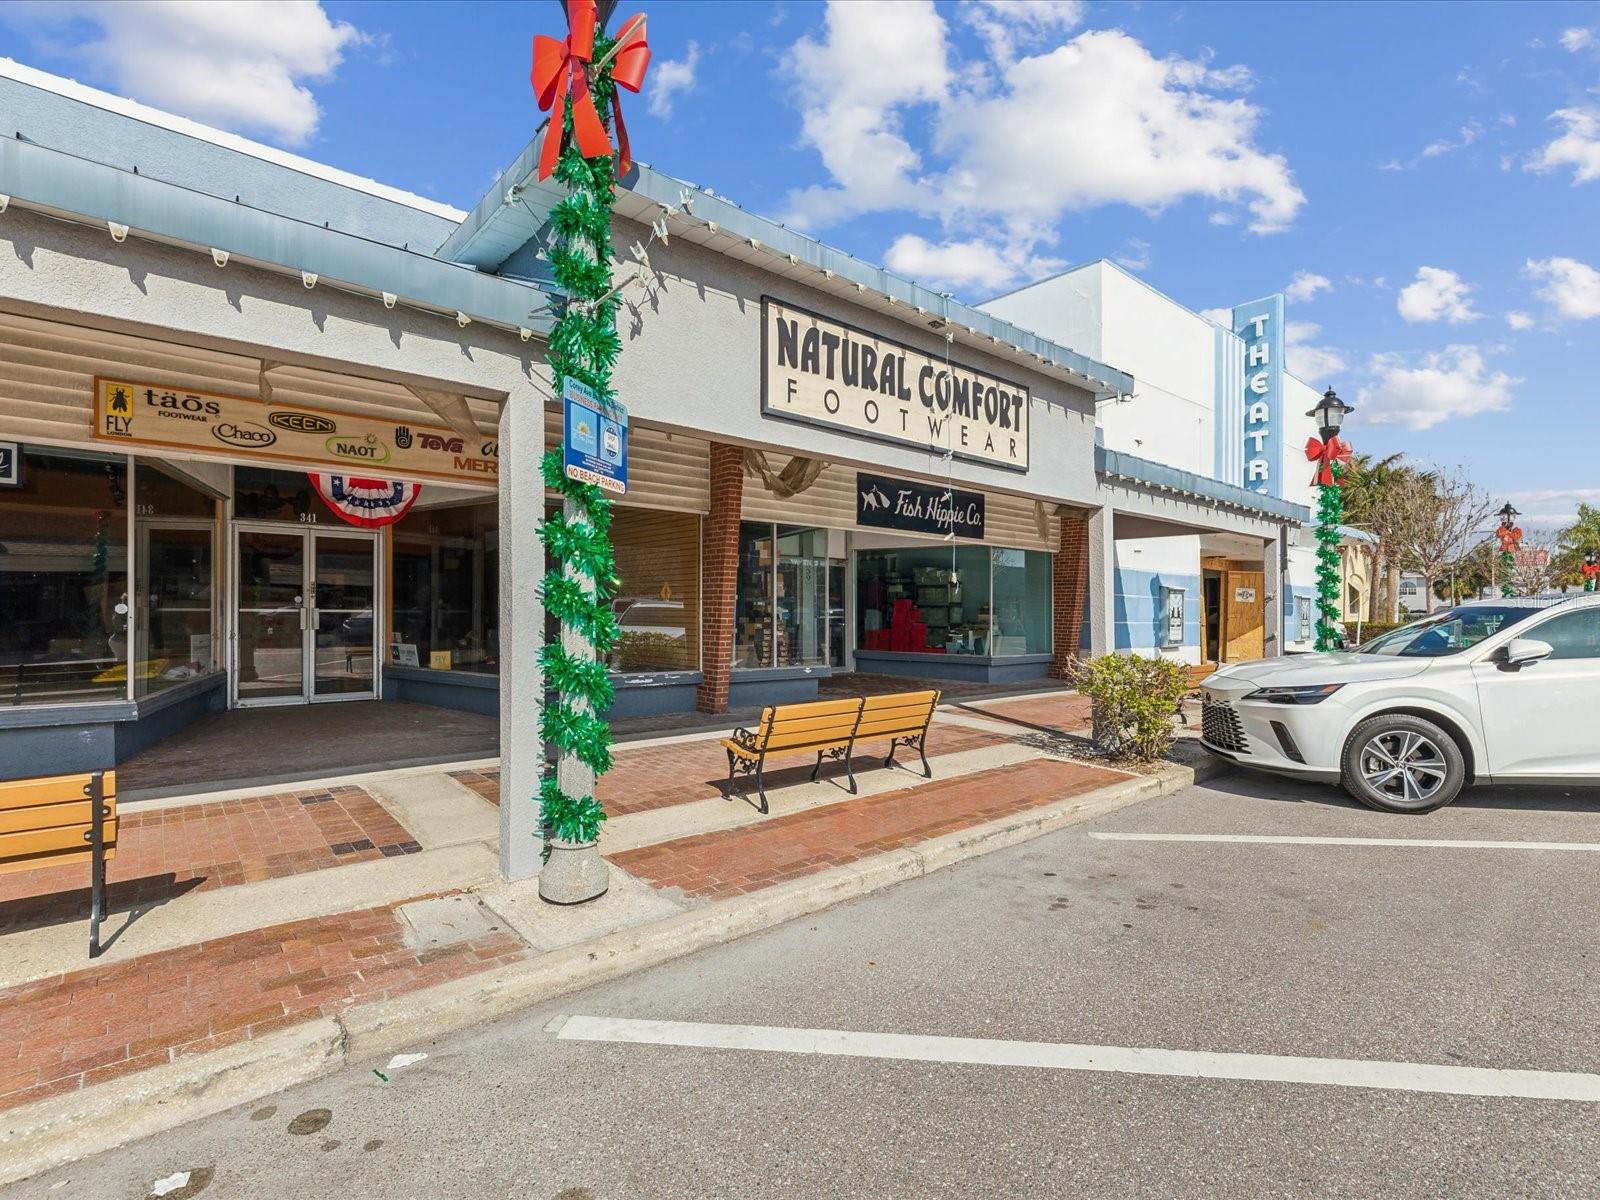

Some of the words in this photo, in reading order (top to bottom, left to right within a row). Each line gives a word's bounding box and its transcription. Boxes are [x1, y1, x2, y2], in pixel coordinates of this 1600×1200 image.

[776, 317, 912, 402] NATURAL
[918, 364, 1023, 433] COMFORT
[1249, 313, 1270, 496] THEATR
[106, 415, 133, 433] FLY
[158, 410, 208, 423] FOOTWEAR
[273, 415, 333, 430] KEEN
[786, 378, 1017, 458] FOOTWEAR
[106, 430, 133, 438] LONDON
[217, 423, 271, 443] Chaco
[336, 442, 377, 458] NAOT
[568, 466, 578, 478] NO
[579, 470, 601, 484] BEACH
[601, 476, 625, 493] PARKING
[299, 513, 317, 523] 341
[894, 490, 923, 518] Fish
[925, 497, 965, 529] Hippie
[967, 503, 982, 526] Co.
